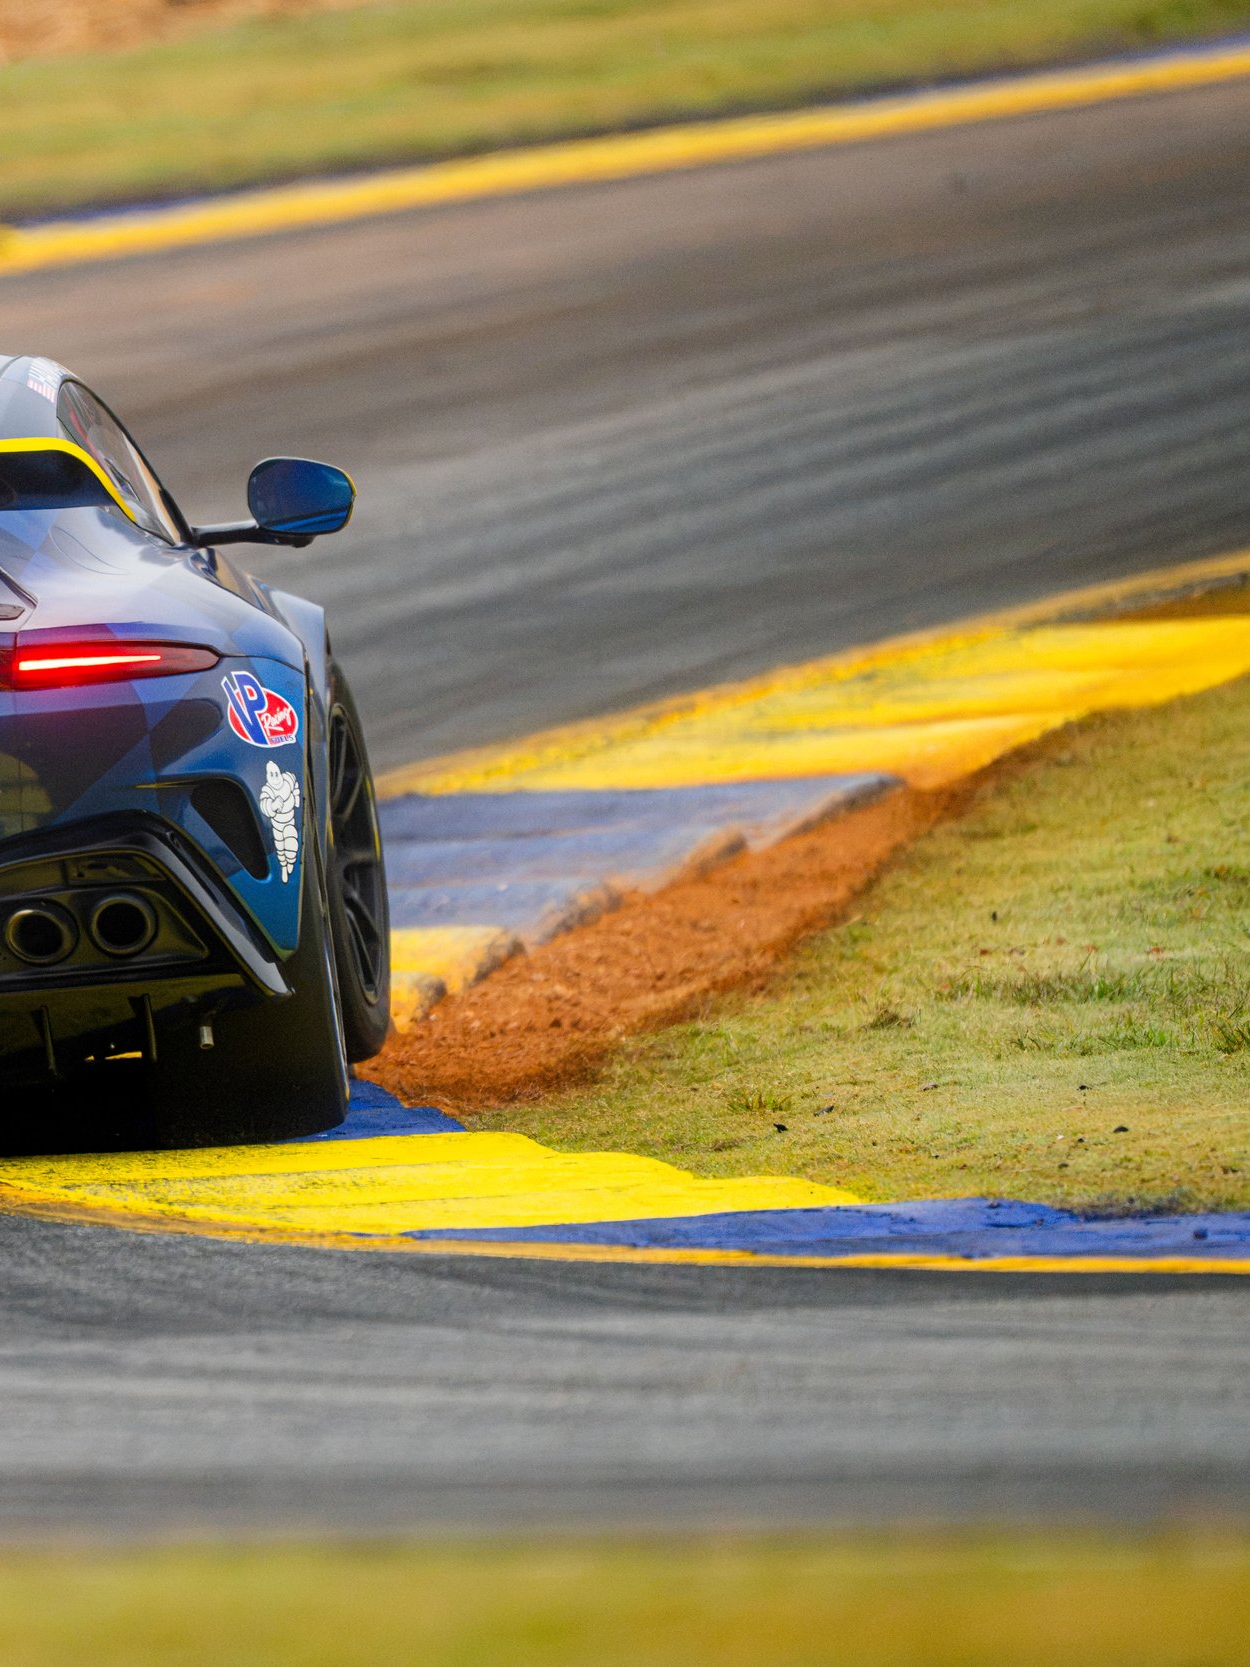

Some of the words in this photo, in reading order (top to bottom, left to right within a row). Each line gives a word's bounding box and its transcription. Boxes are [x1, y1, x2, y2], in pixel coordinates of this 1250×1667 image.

[221, 671, 268, 745] VP
[261, 707, 292, 736] Racing
[269, 735, 294, 744] FUELS
